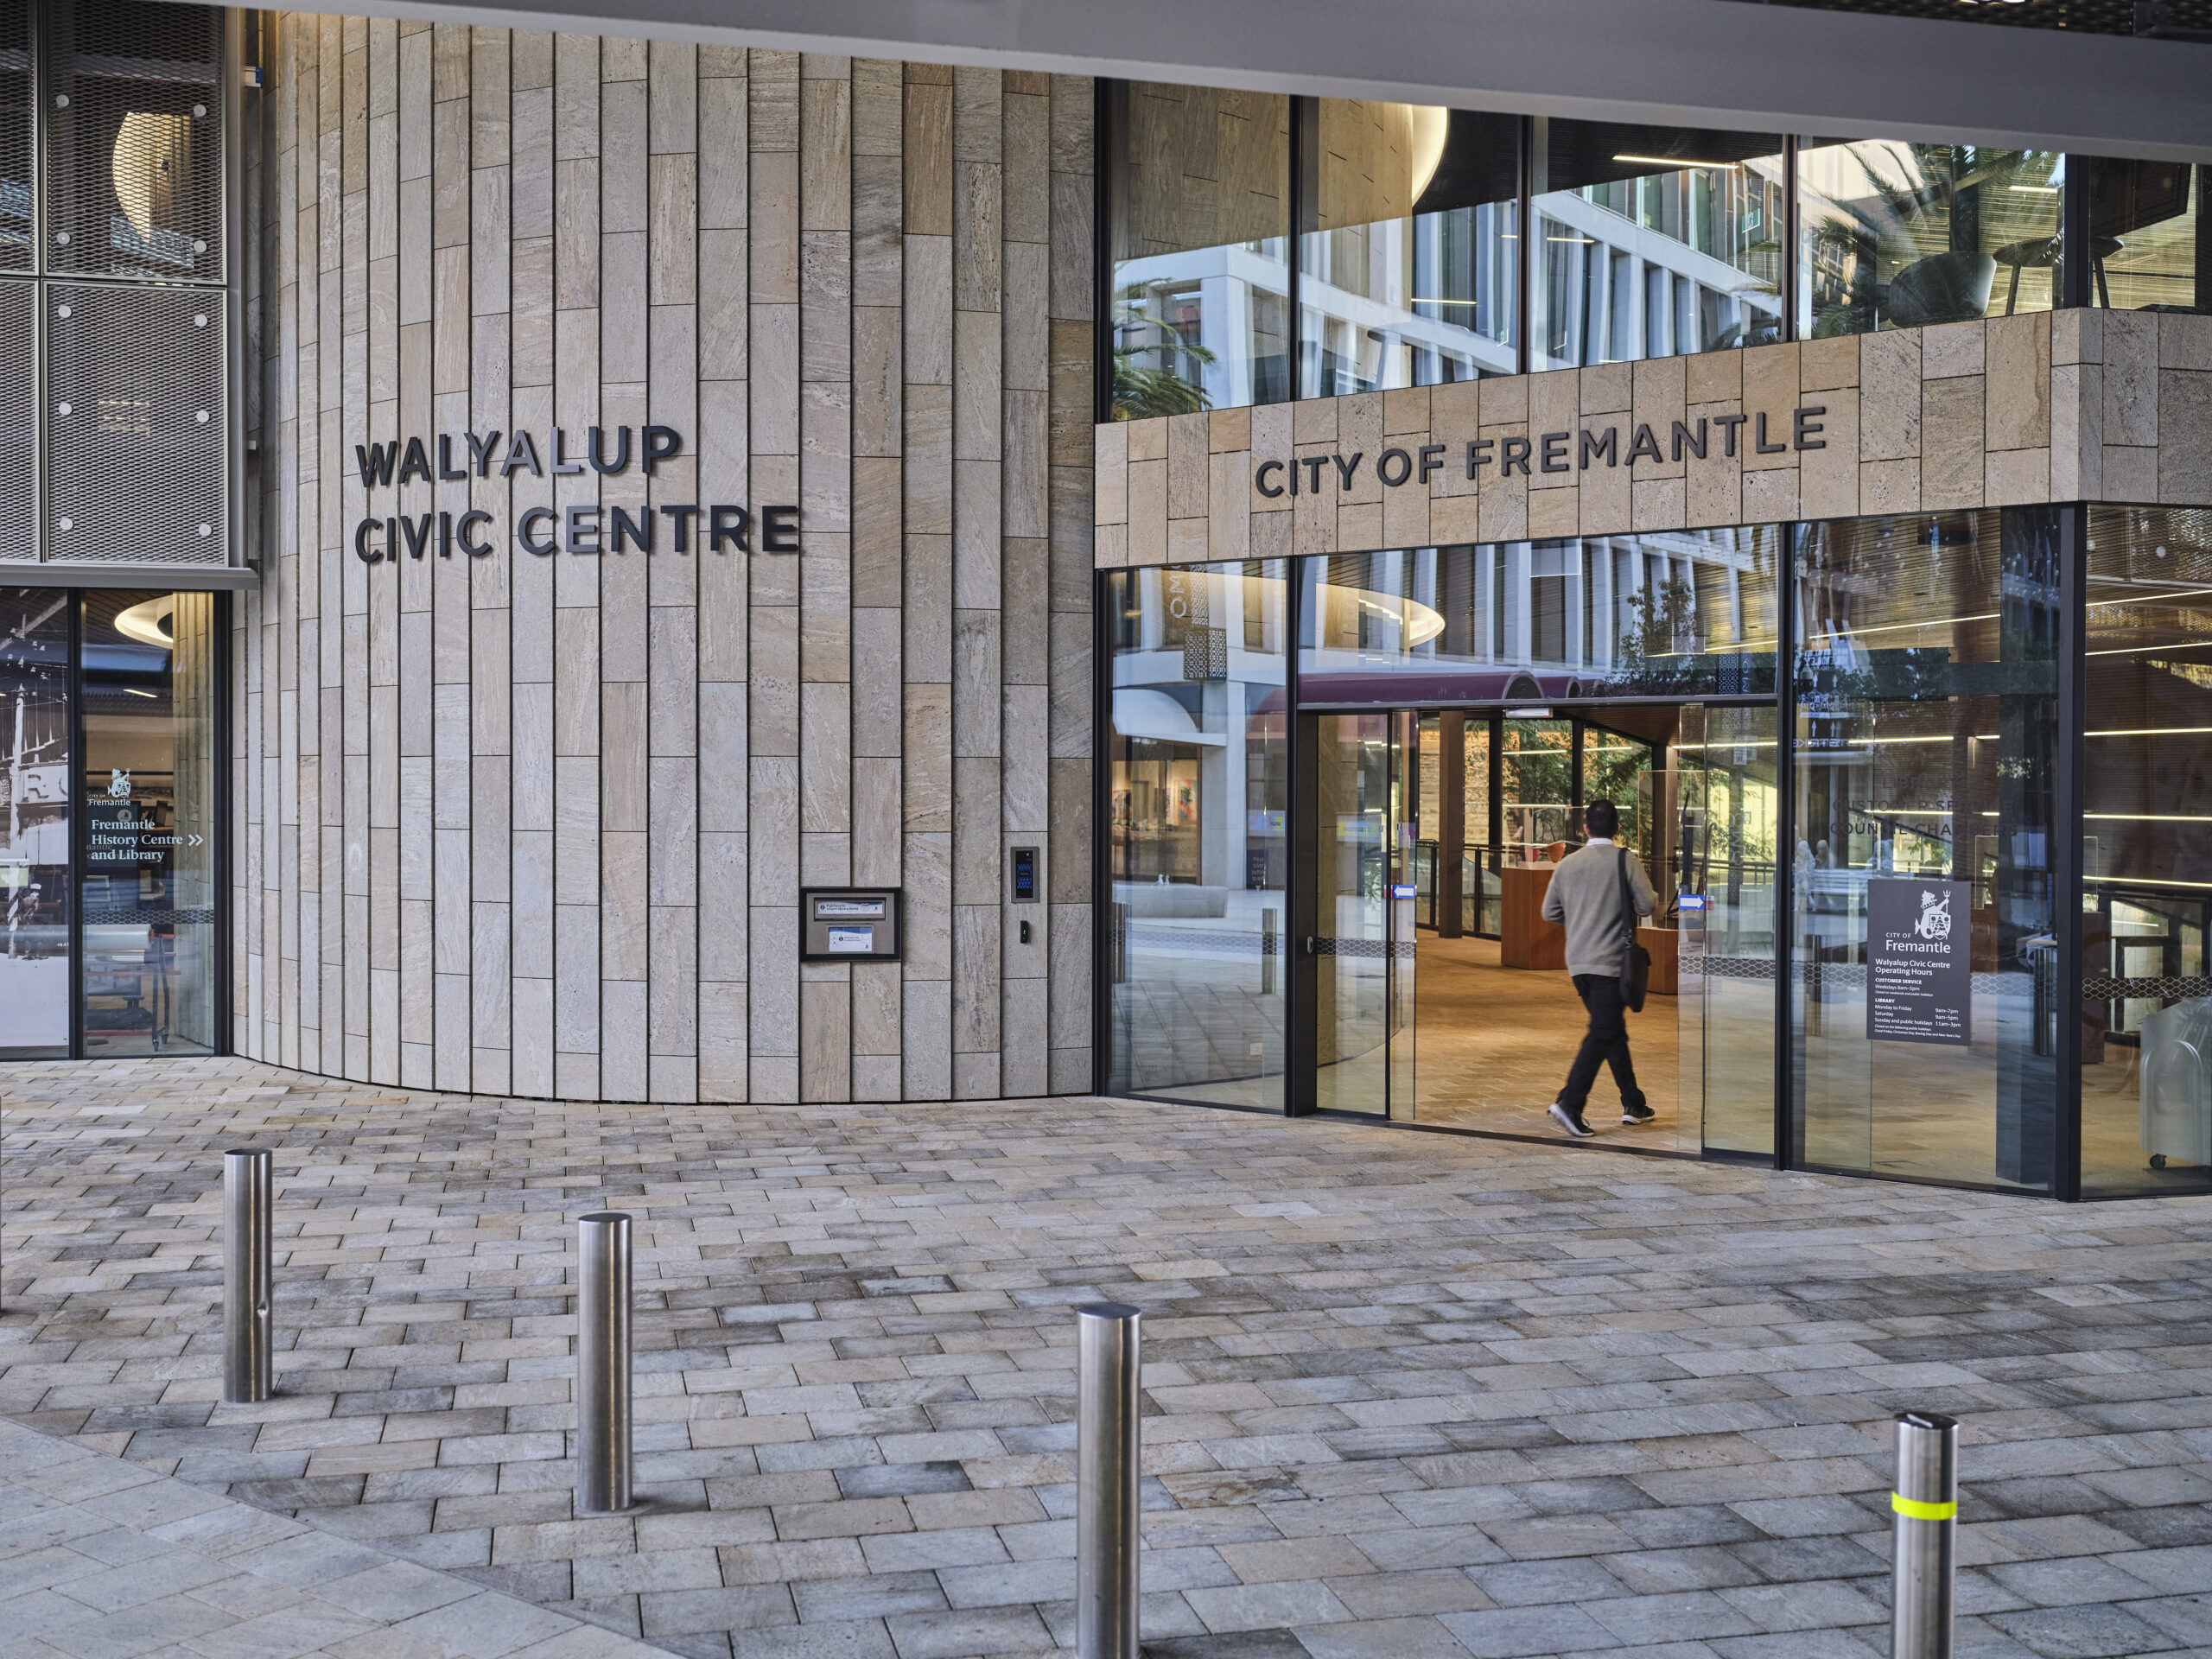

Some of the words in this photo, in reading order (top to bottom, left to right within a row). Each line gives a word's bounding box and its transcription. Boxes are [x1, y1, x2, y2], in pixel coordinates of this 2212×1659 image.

[355, 425, 680, 488] WALYALUP
[1255, 451, 1363, 498] CITY
[1376, 444, 1446, 487] OF
[1466, 406, 1826, 480] FREMANTLE
[355, 509, 492, 563] CIVIC
[518, 505, 798, 556] CENTRE
[1882, 775, 1964, 790] LIBRARY
[1832, 798, 1929, 813] CUSTOMER
[92, 820, 156, 830] Fremantle
[1830, 821, 1908, 836] COUNCIL
[92, 835, 138, 847] History
[141, 835, 183, 845] Centre
[92, 849, 116, 860] and
[118, 849, 164, 862] Library
[1885, 939, 1951, 954] Fremantle
[1875, 958, 1909, 968] Walyalup
[1875, 967, 1910, 976] Operating
